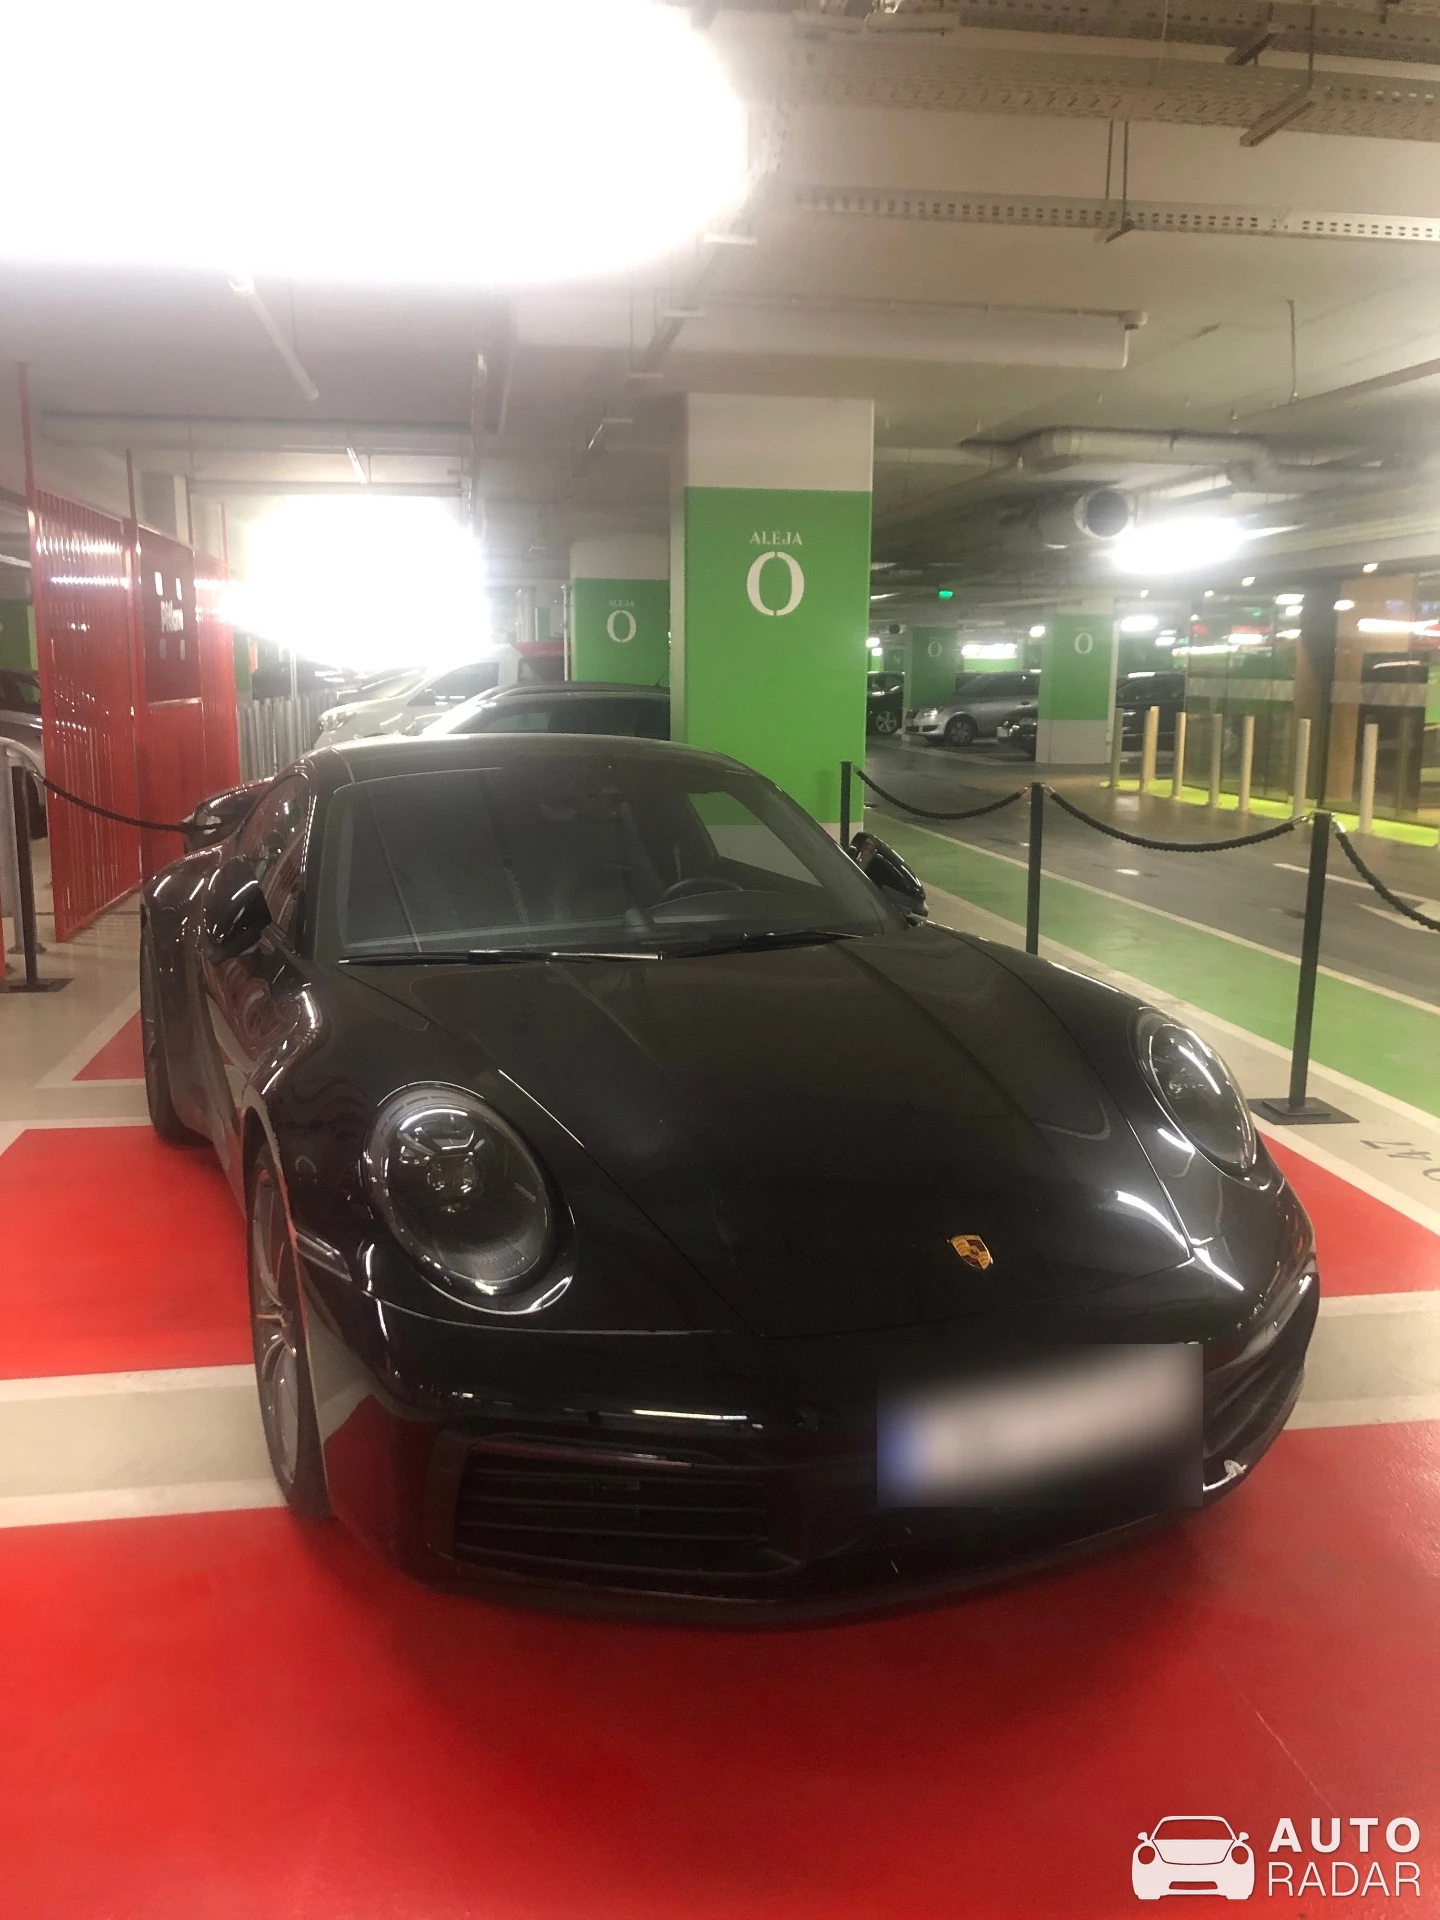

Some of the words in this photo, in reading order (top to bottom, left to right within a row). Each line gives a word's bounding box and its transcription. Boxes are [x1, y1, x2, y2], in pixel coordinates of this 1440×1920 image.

[750, 531, 803, 545] ALEJA
[747, 552, 804, 616] O
[607, 610, 636, 642] O
[928, 640, 942, 657] O
[1074, 632, 1093, 654] O
